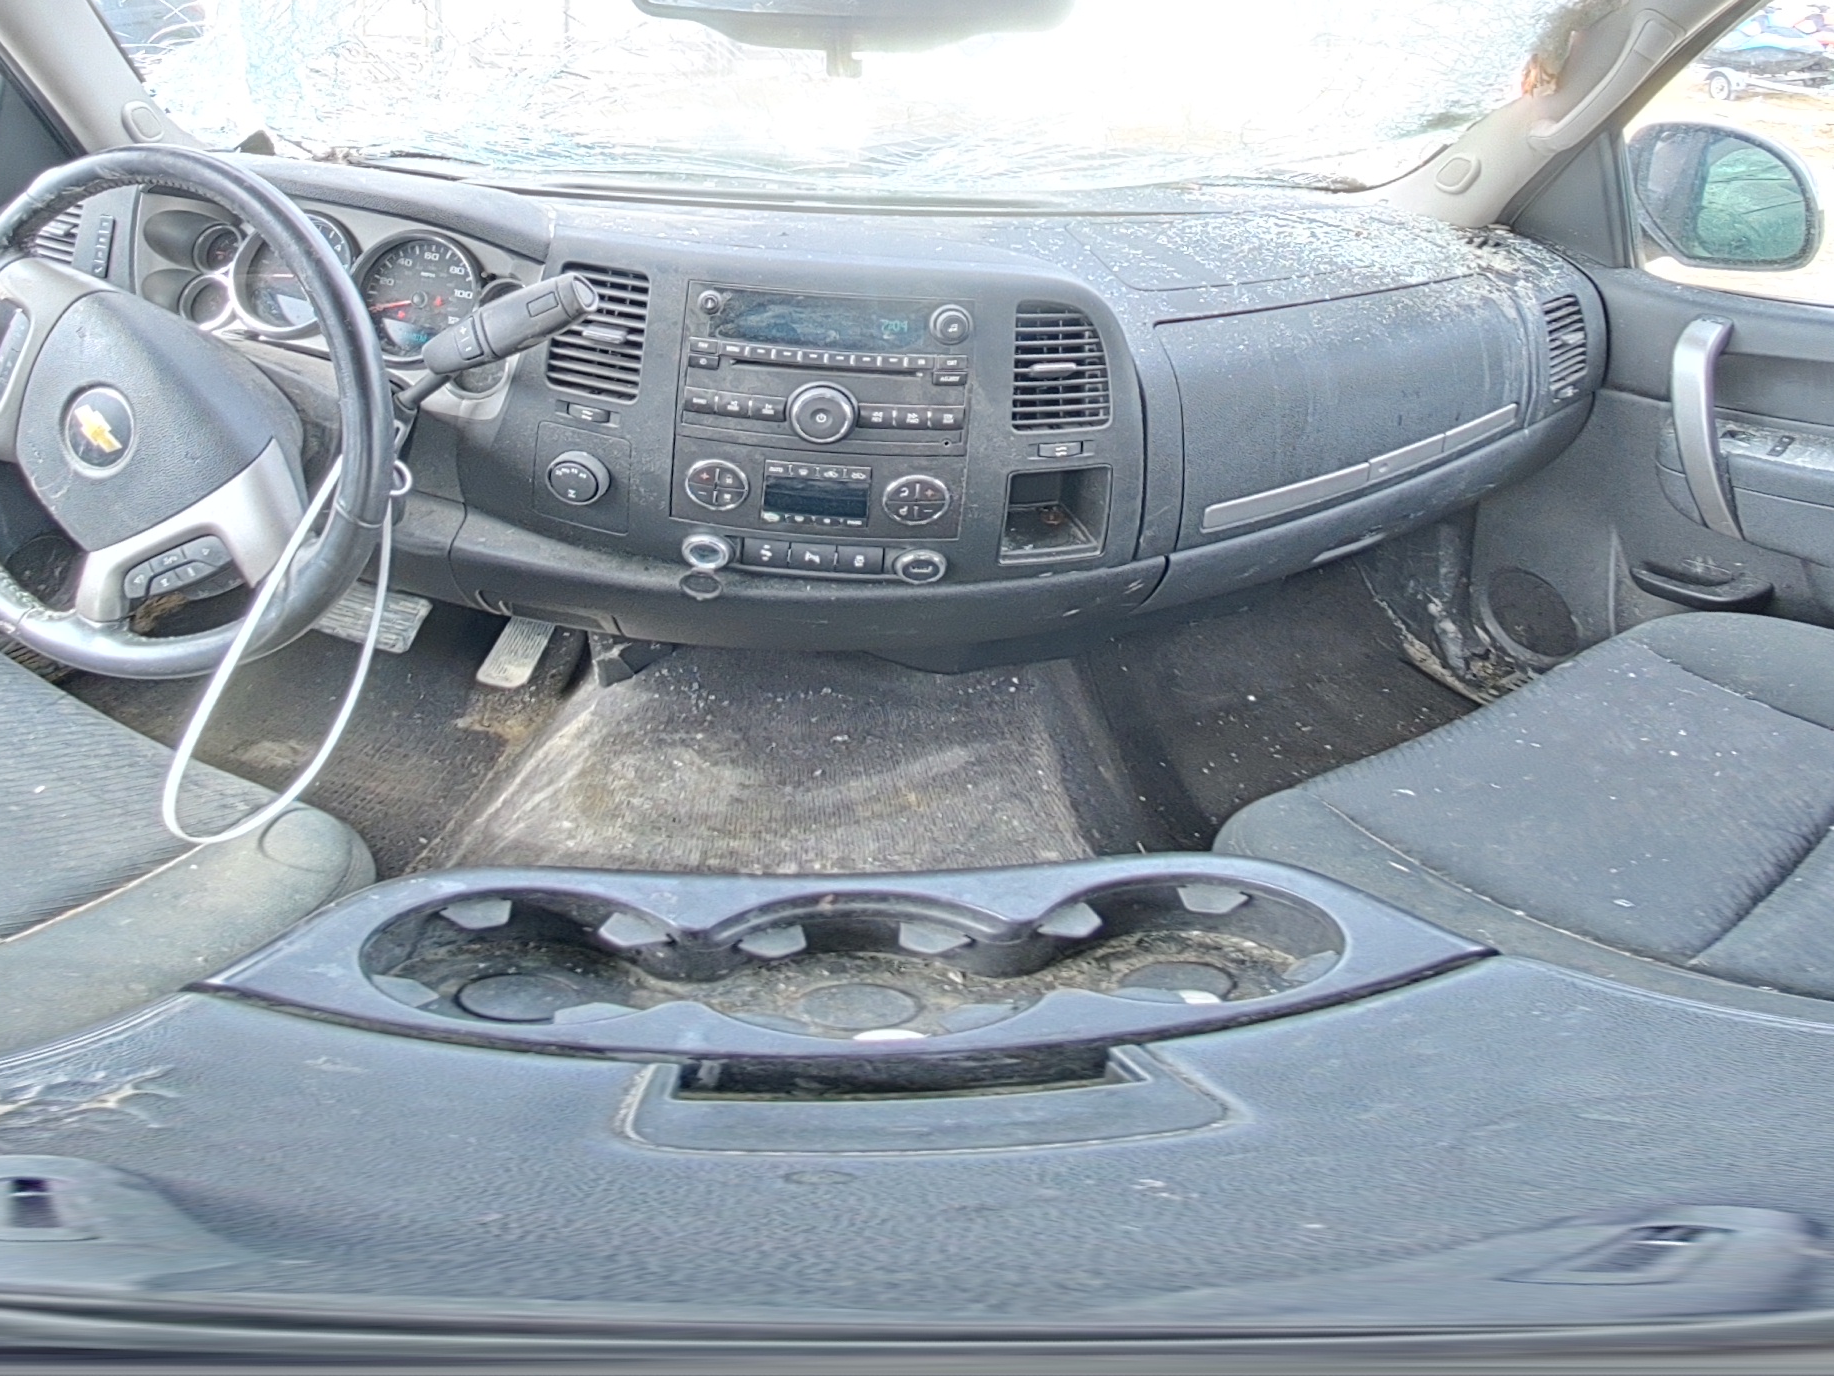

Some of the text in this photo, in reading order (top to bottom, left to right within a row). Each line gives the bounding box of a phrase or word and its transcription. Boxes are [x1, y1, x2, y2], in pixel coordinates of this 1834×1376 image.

[424, 251, 440, 261] 60
[396, 257, 413, 267] 40
[449, 265, 465, 275] 80
[379, 276, 395, 286] 20
[454, 289, 473, 299] 100
